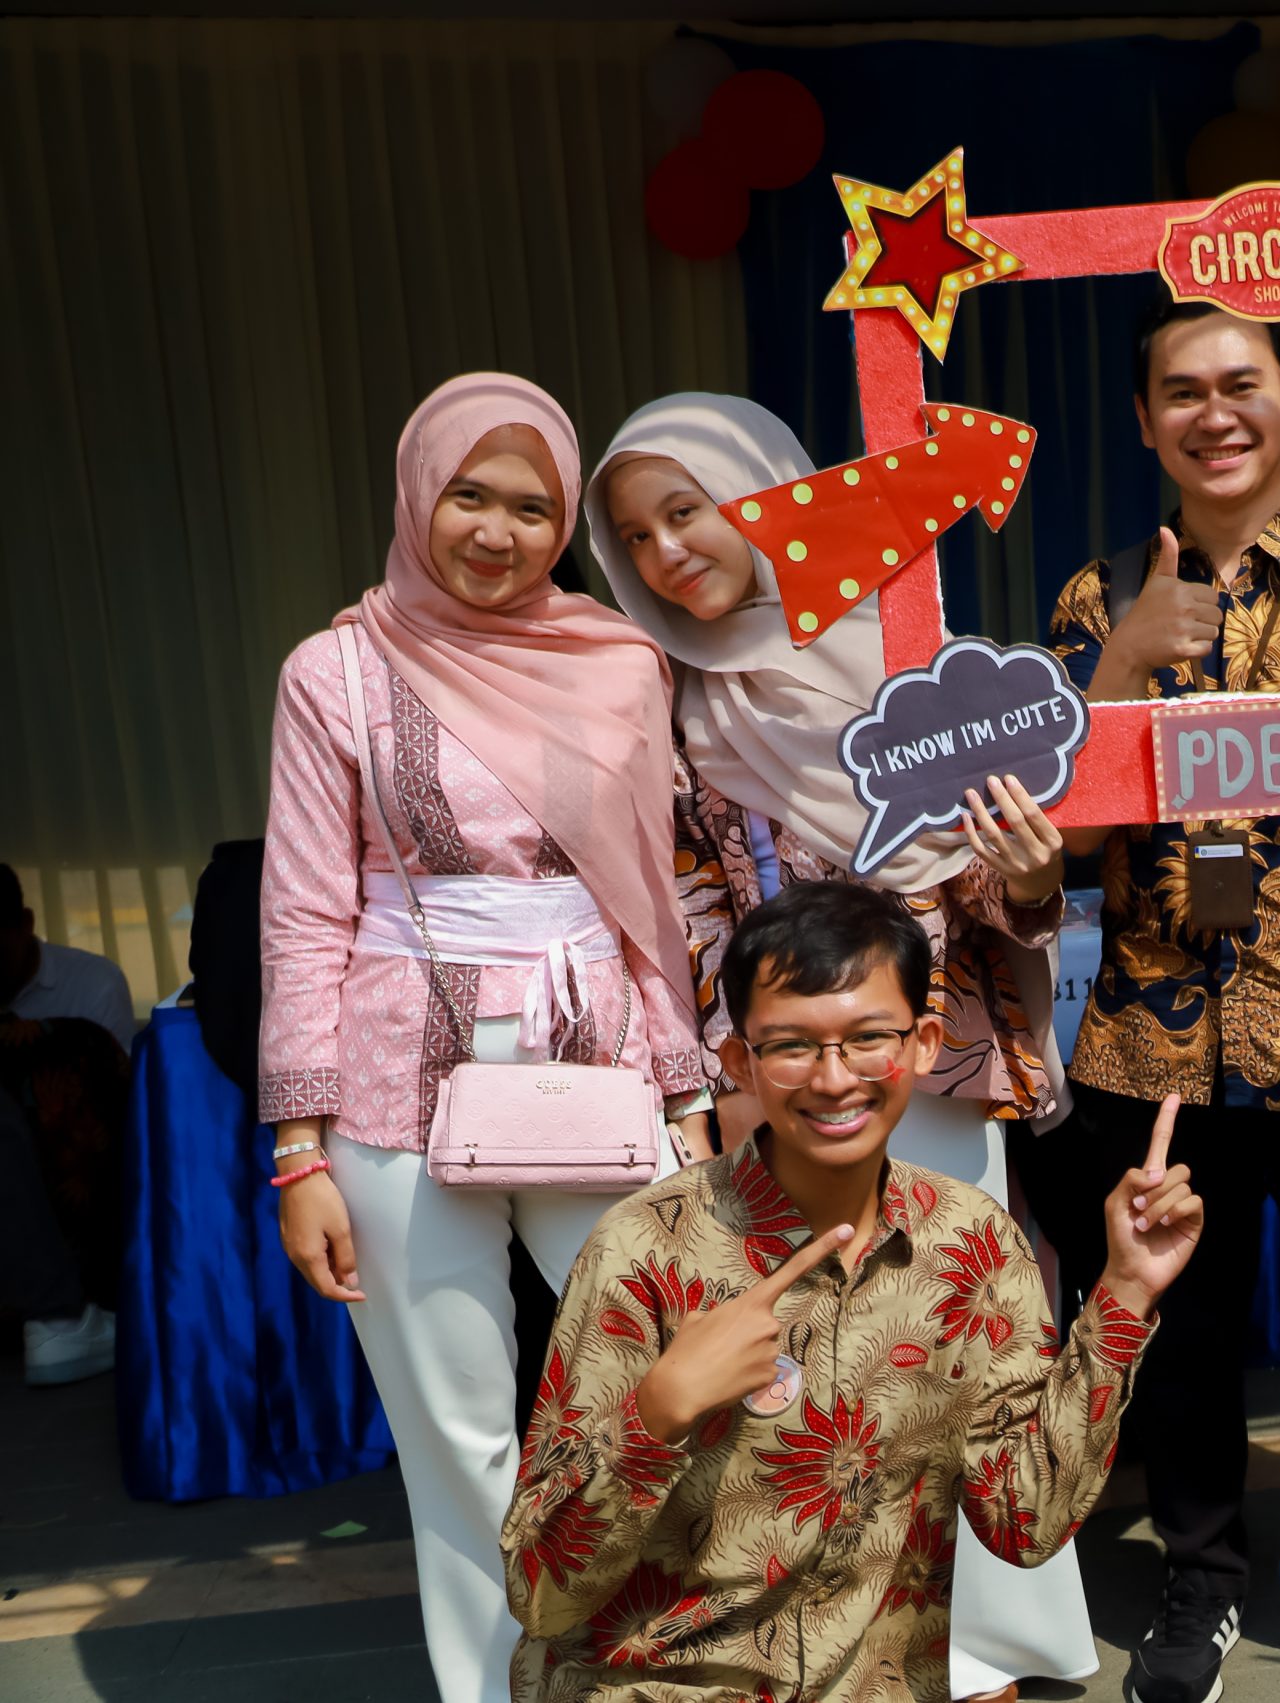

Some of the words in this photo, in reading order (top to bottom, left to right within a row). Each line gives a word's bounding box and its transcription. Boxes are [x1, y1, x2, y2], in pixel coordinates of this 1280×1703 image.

[1223, 201, 1268, 228] WELCOME
[870, 752, 883, 777] I
[884, 729, 956, 773] KNOW
[960, 718, 996, 749] I'M
[1001, 695, 1067, 736] CUTE
